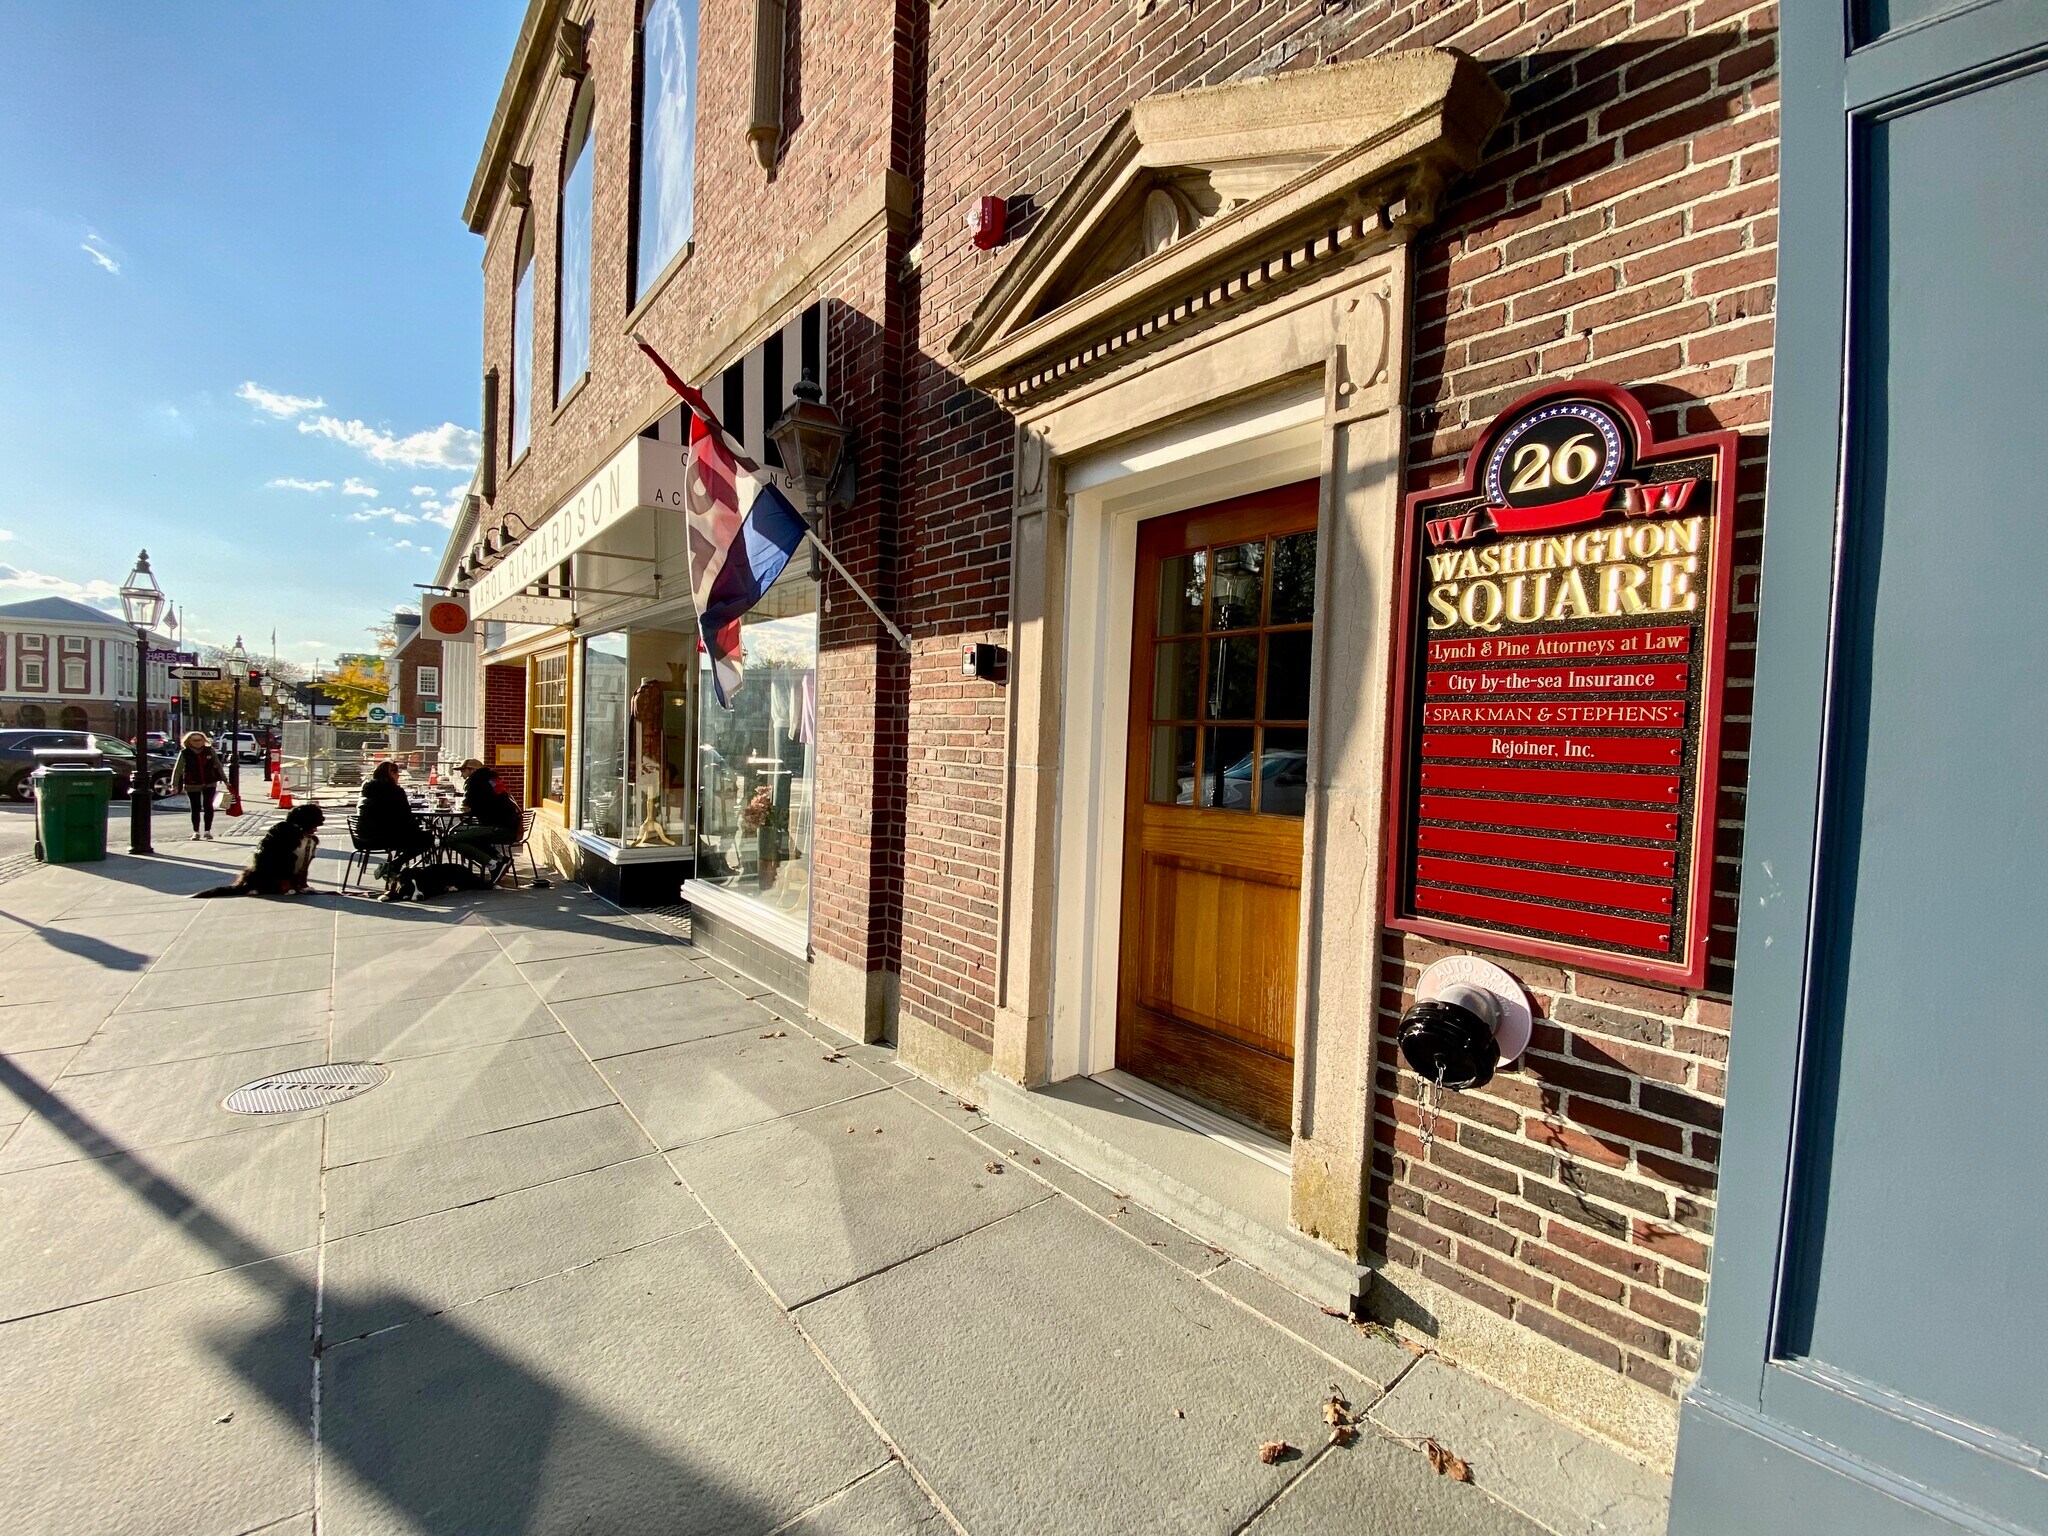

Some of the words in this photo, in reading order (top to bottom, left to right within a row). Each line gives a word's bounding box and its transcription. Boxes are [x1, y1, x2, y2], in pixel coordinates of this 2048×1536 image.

[1508, 433, 1597, 494] 26
[474, 571, 503, 612] KAROL
[508, 463, 621, 590] RICHARDSON
[1426, 516, 1703, 582] WASHINGTON
[1427, 555, 1698, 632] SQUARE
[1434, 642, 1476, 663] Lynch
[1480, 641, 1492, 657] &
[1497, 641, 1530, 656] Pine
[1535, 638, 1615, 657] Attorneys
[1620, 635, 1638, 651] at
[1644, 632, 1682, 650] Law
[1448, 674, 1477, 693] City
[1481, 672, 1562, 693] by-the-sea
[1568, 671, 1655, 688] Insurance
[1433, 707, 1532, 722] SPARKMAN
[1537, 707, 1553, 722] &
[1491, 738, 1559, 759] Rejoiner,
[1564, 740, 1595, 758] Inc.
